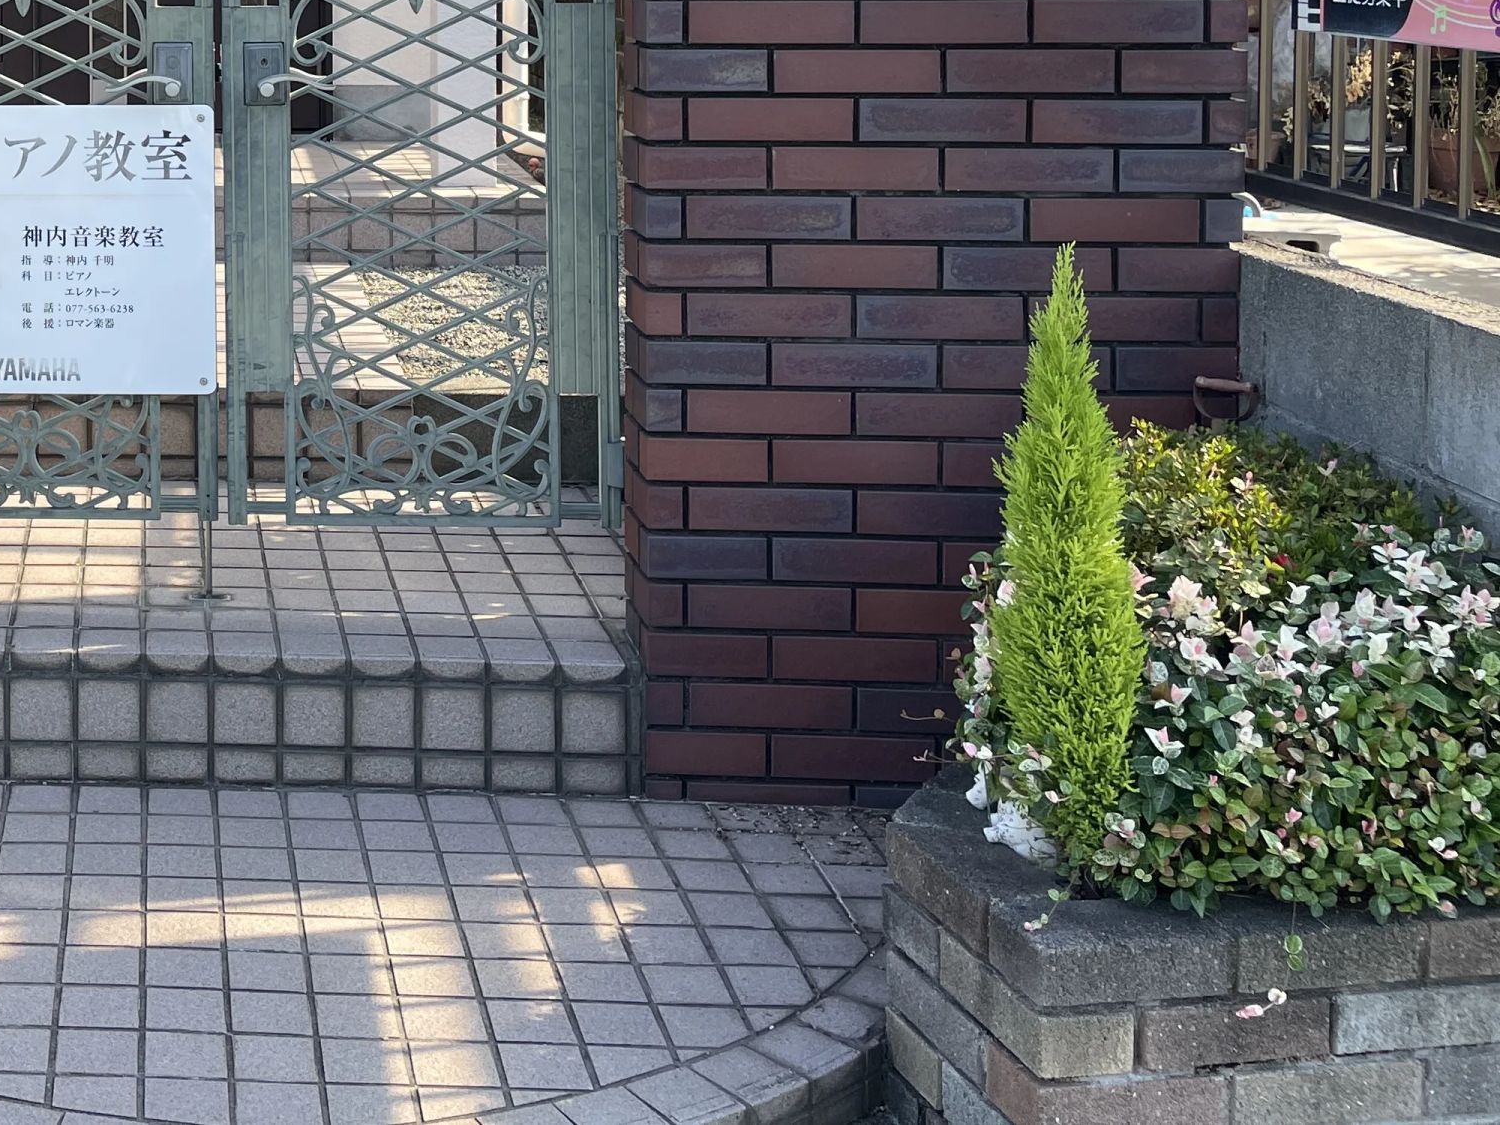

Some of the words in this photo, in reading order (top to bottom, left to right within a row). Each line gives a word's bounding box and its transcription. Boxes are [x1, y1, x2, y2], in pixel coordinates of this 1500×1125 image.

[21, 225, 165, 249] 神内音楽教室
[64, 286, 120, 297] エレクトーン
